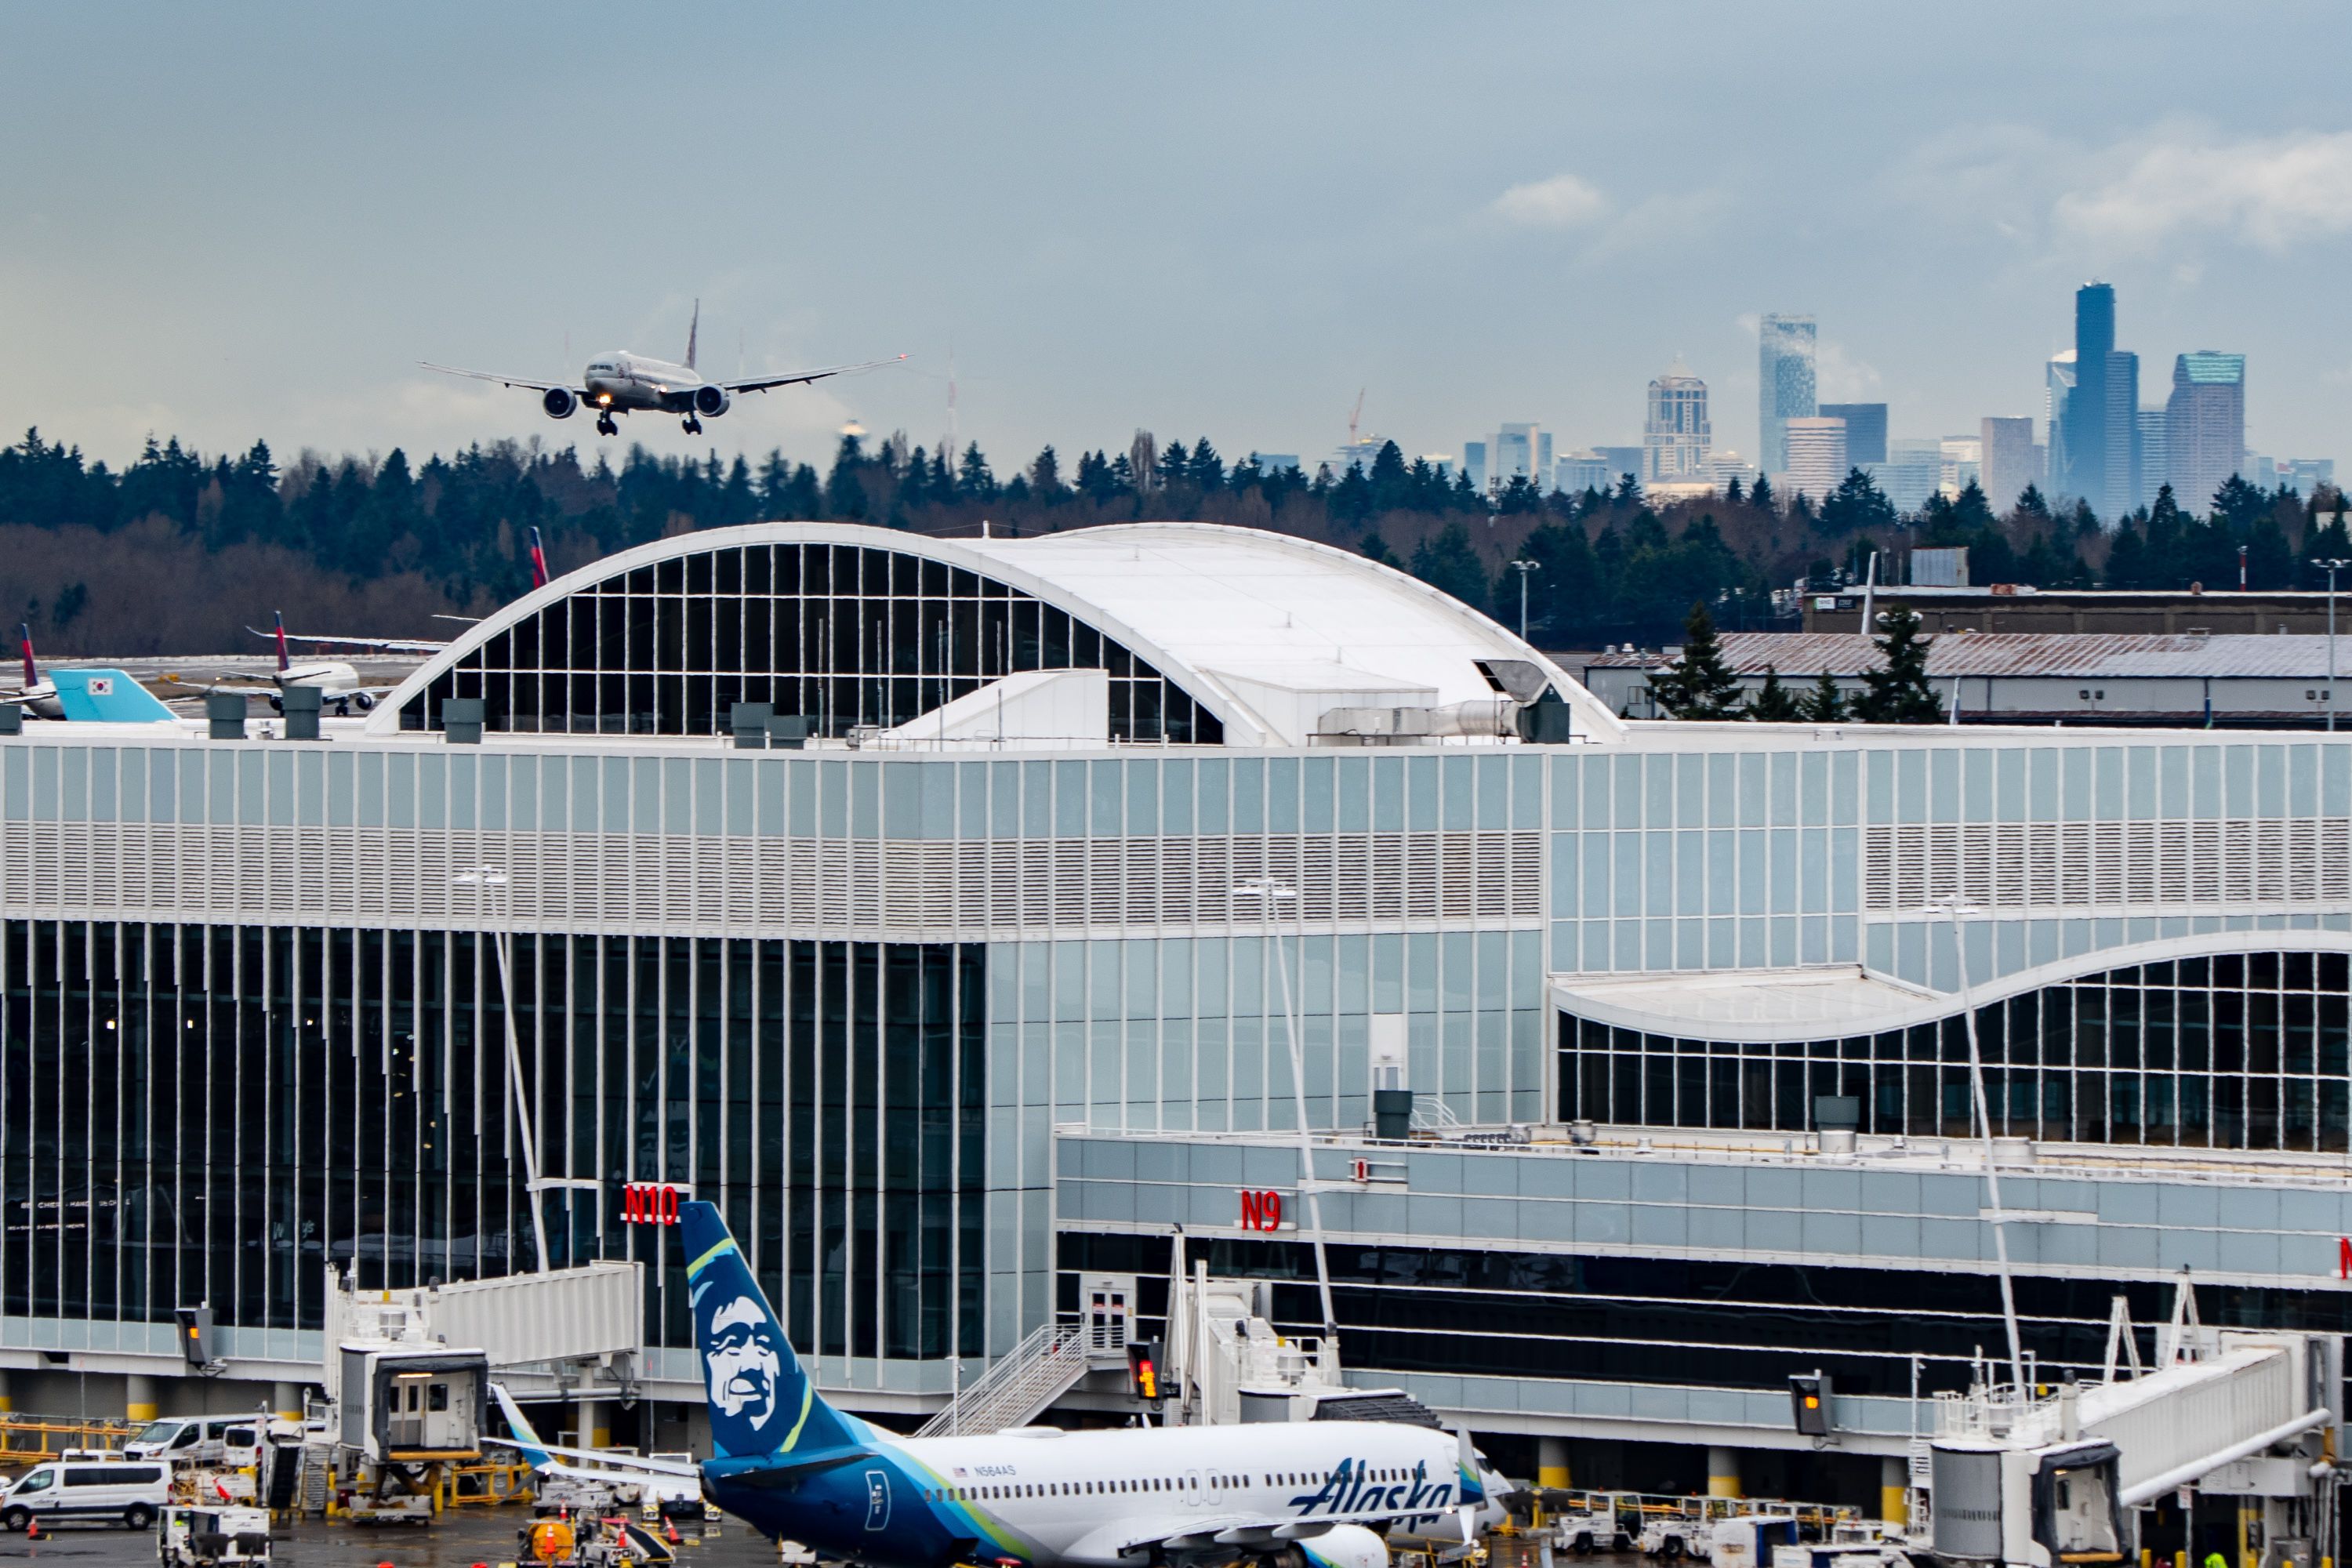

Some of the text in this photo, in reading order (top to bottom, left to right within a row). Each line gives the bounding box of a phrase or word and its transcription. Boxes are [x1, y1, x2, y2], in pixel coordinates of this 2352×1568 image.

[626, 1185, 677, 1226] N10
[1242, 1190, 1280, 1232] N9
[974, 1465, 1016, 1476] N564AS
[1287, 1457, 1453, 1534] Alaska
